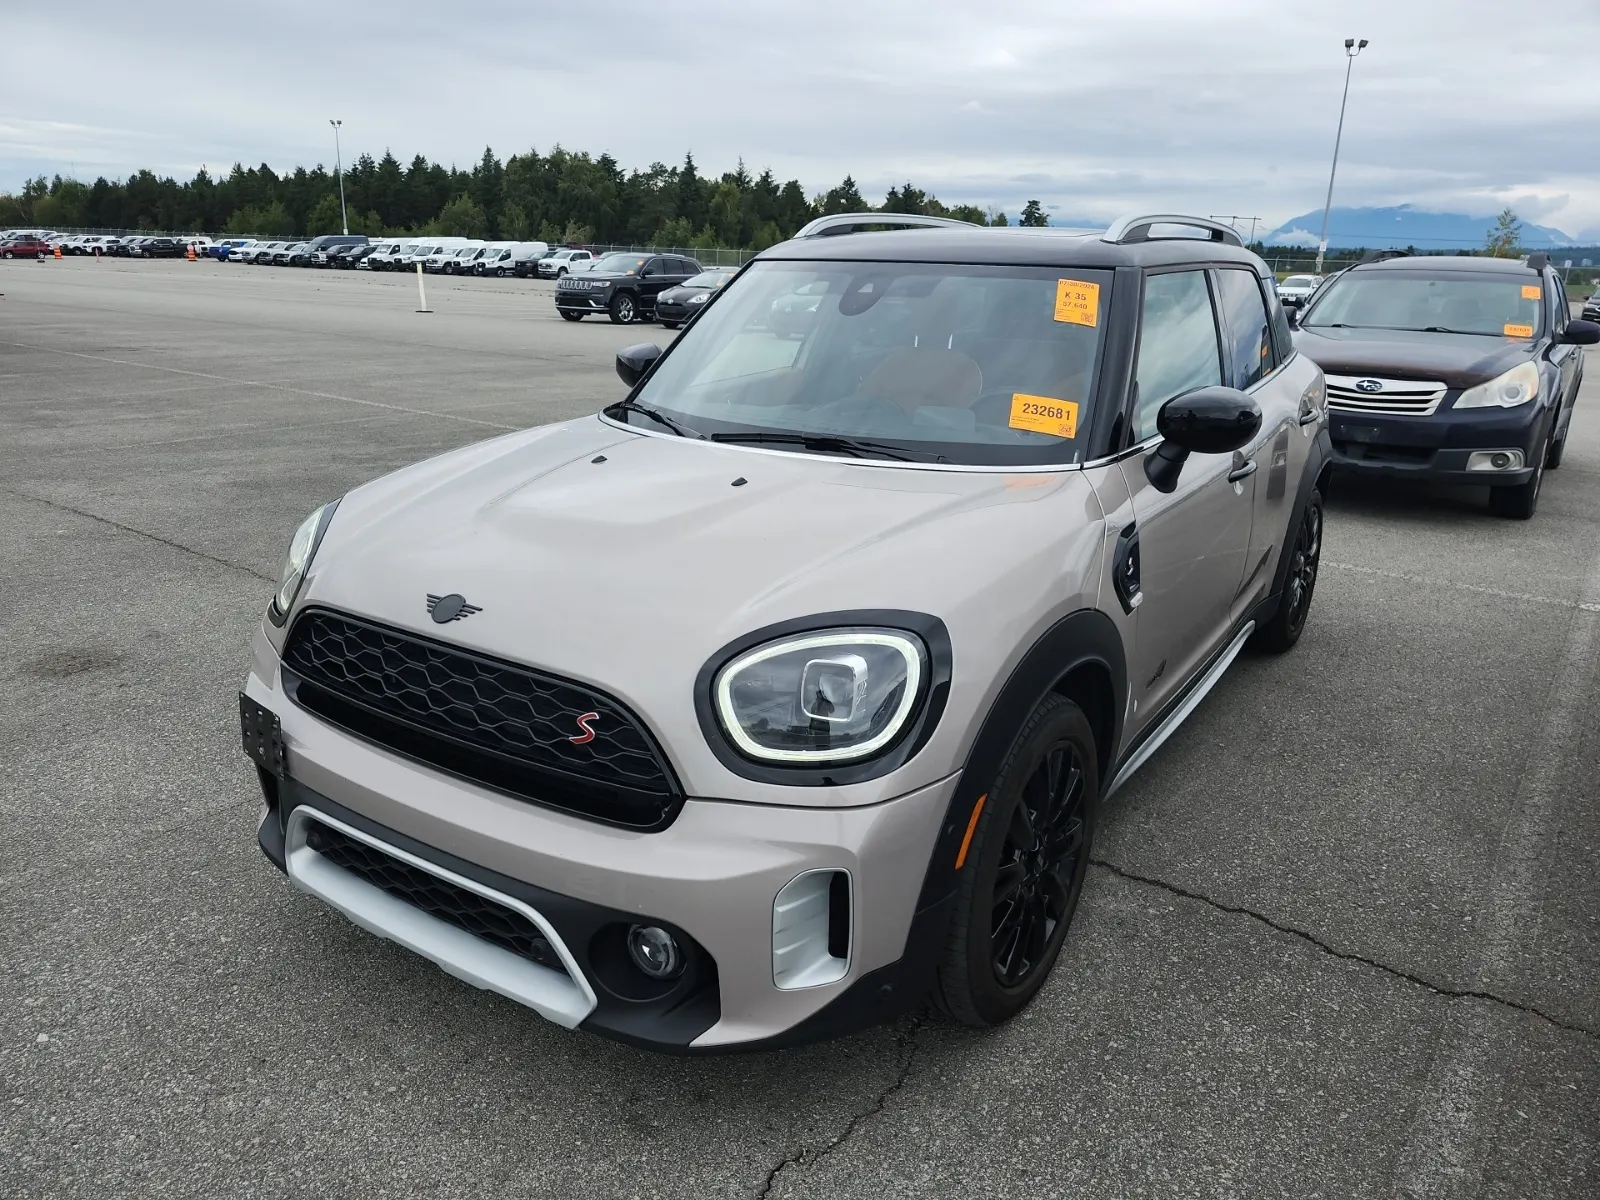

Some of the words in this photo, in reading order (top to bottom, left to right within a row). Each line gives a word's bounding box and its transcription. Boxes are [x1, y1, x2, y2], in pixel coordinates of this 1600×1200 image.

[1075, 293, 1087, 301] 35
[1022, 402, 1071, 421] 232681
[568, 711, 600, 745] S
